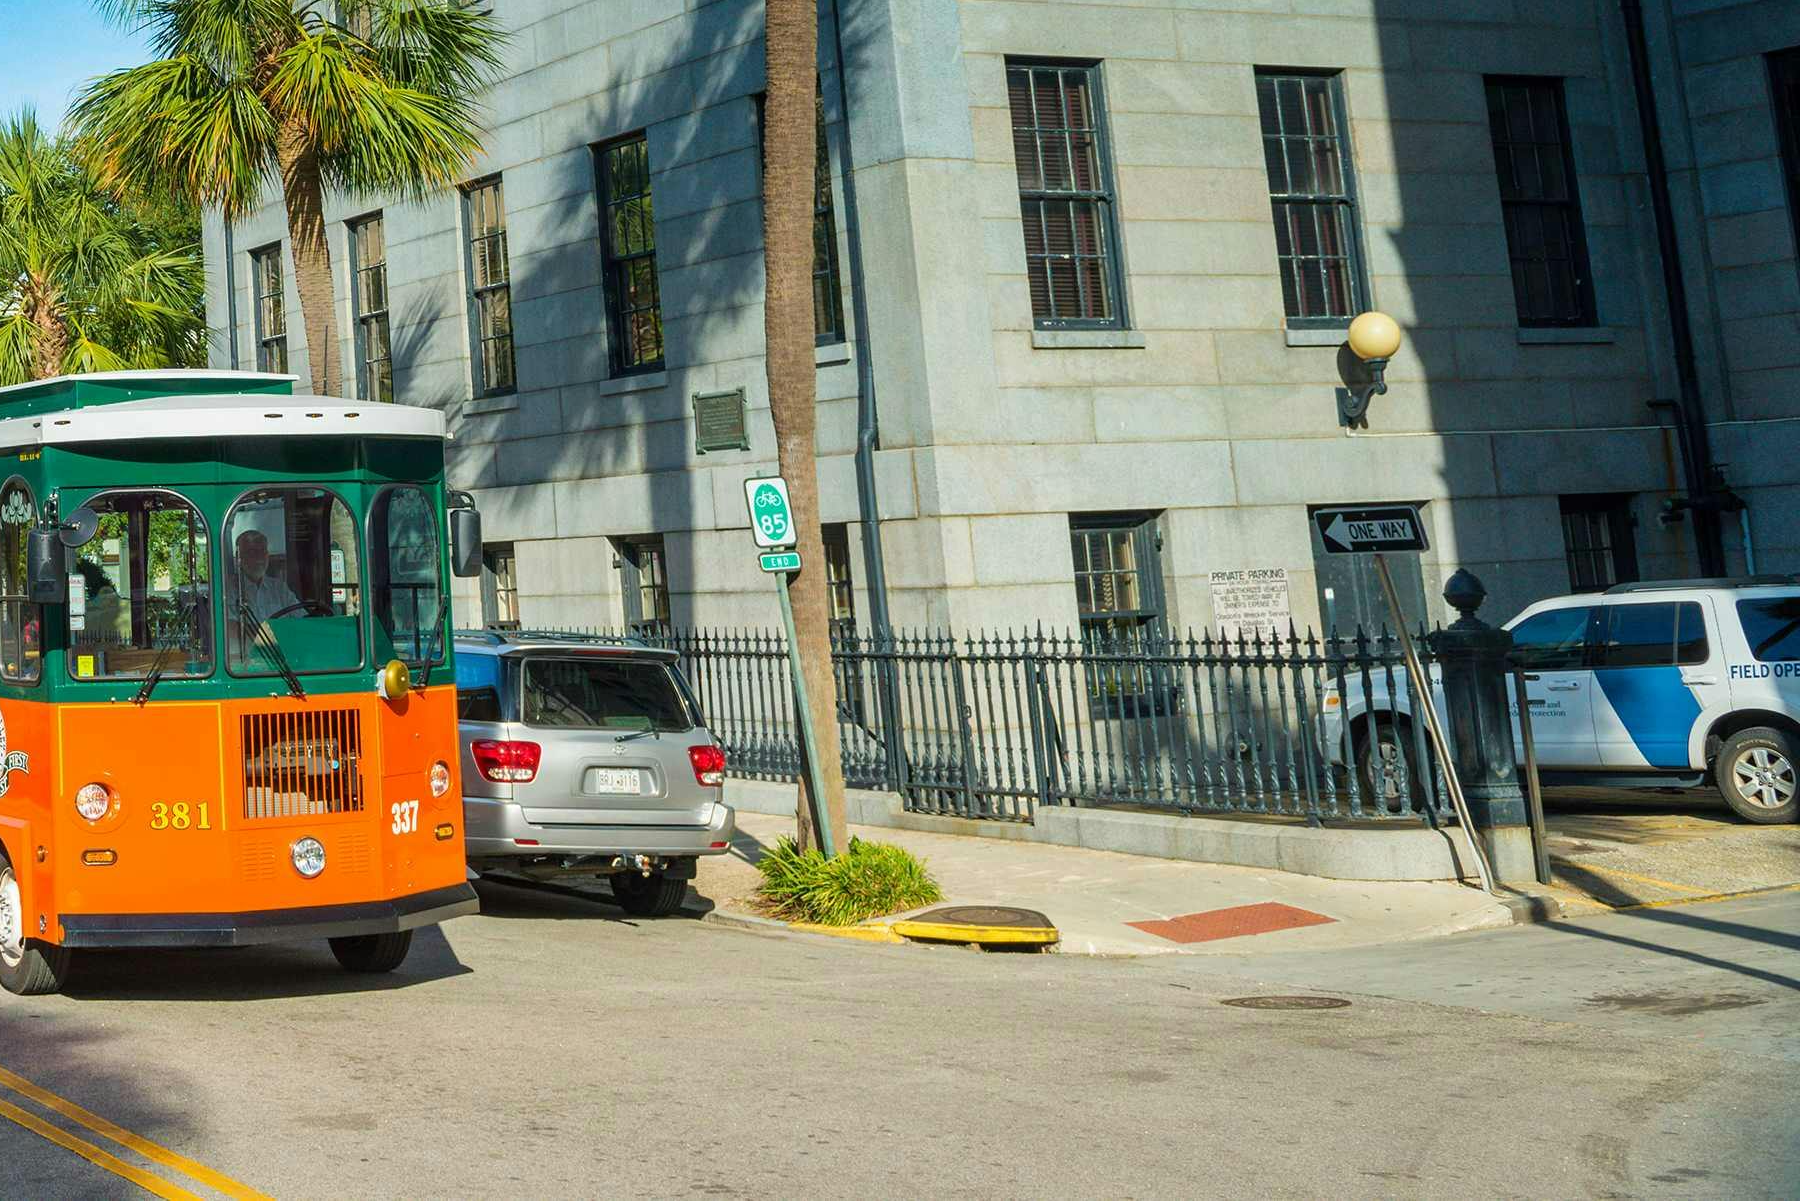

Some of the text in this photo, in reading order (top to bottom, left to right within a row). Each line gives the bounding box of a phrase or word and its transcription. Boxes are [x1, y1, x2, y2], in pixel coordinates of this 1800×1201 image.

[761, 513, 787, 535] 85
[1348, 521, 1406, 540] ONE WAY
[770, 557, 789, 567] END
[1211, 568, 1285, 581] PRIVATE PARKING
[1730, 664, 1770, 679] FIELD
[8, 753, 27, 769] FIRST
[150, 801, 211, 830] 381
[391, 799, 419, 835] 337
